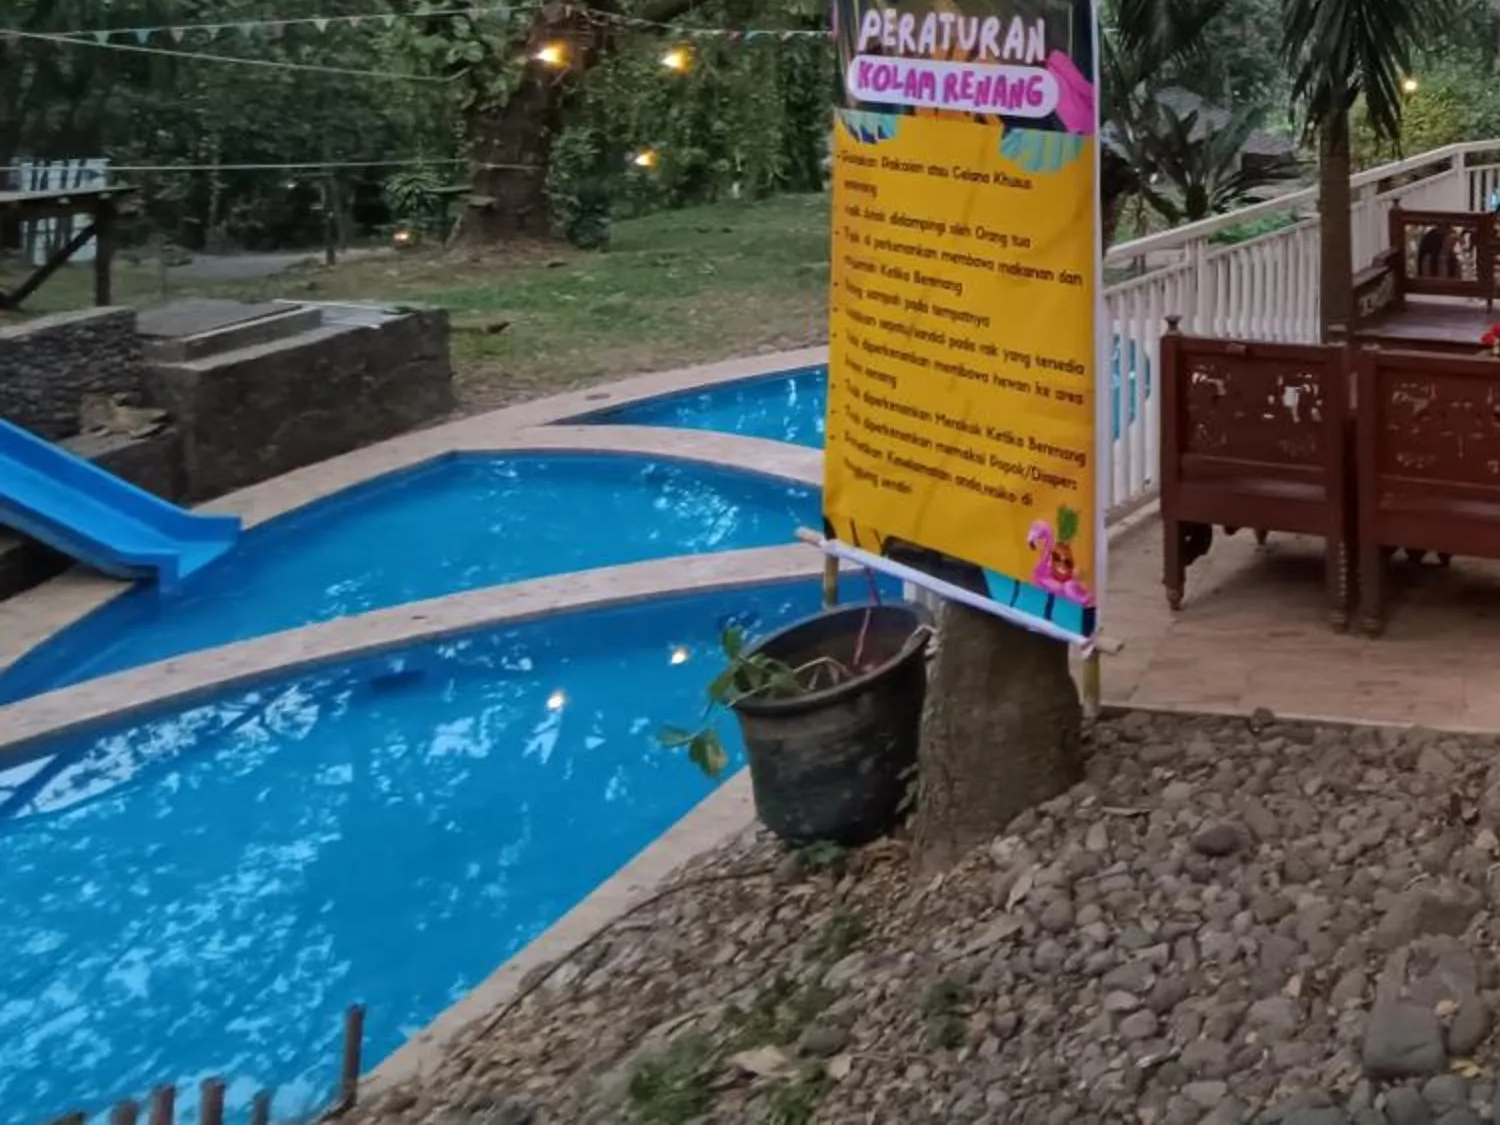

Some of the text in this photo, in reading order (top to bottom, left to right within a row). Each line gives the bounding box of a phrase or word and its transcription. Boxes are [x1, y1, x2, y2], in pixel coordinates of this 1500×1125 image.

[857, 8, 1046, 64] PERATURAN
[858, 60, 1044, 112] KOLAM RENANG
[975, 225, 1008, 249] Orang
[1011, 235, 1031, 249] tua
[998, 261, 1055, 281] makanan
[1058, 269, 1083, 287] dan
[1003, 348, 1031, 369] yang
